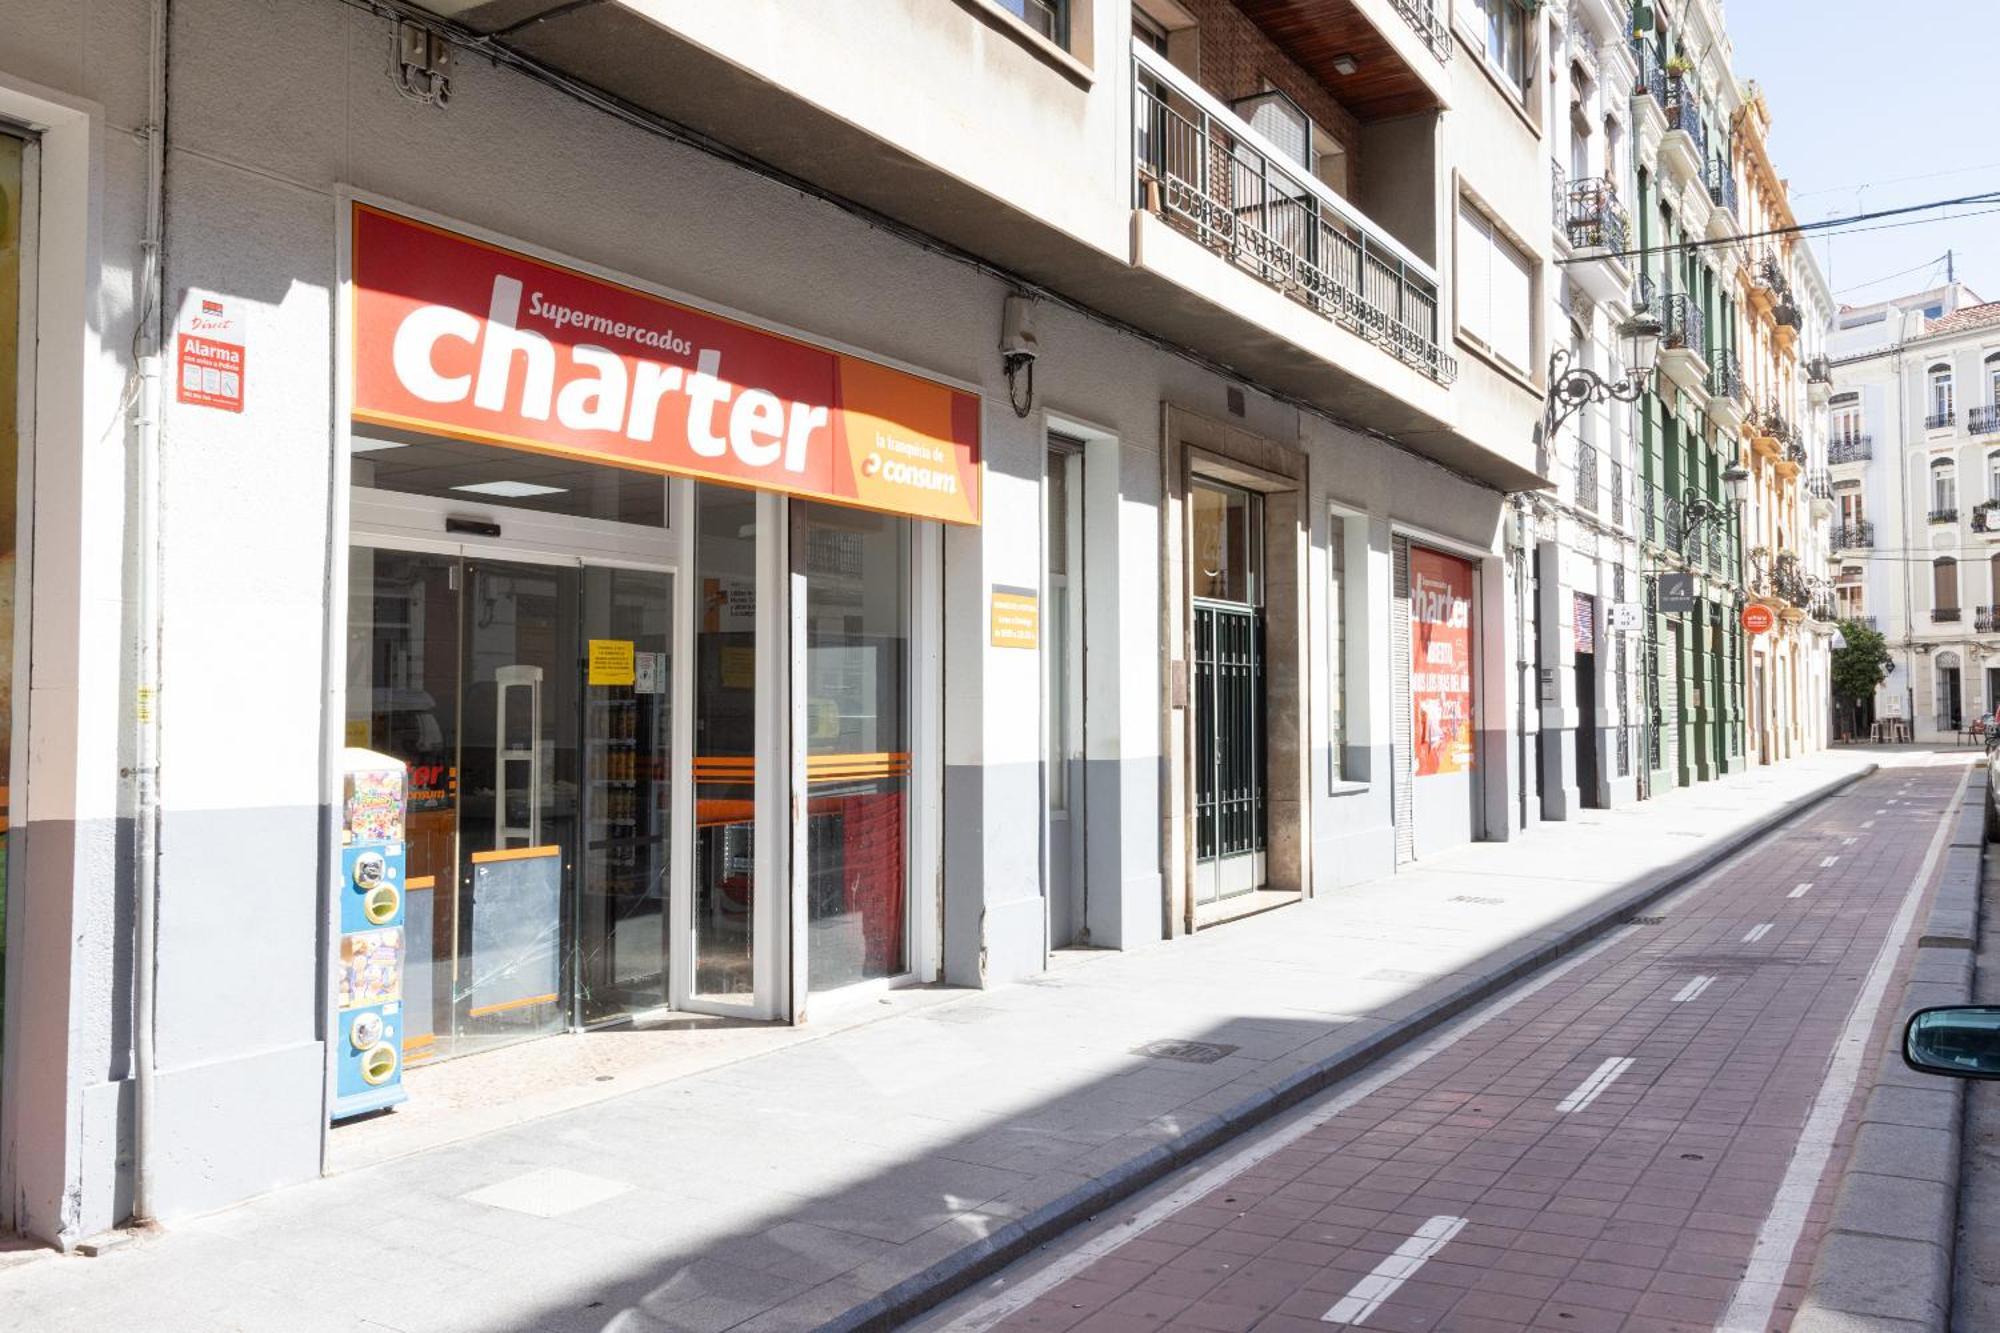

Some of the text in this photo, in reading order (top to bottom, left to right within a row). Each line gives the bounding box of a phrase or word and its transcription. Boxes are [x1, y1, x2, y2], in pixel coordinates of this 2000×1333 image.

[529, 292, 692, 356] Supermercados
[184, 339, 240, 363] Alarma
[392, 274, 827, 473] charter
[882, 460, 957, 494] consum
